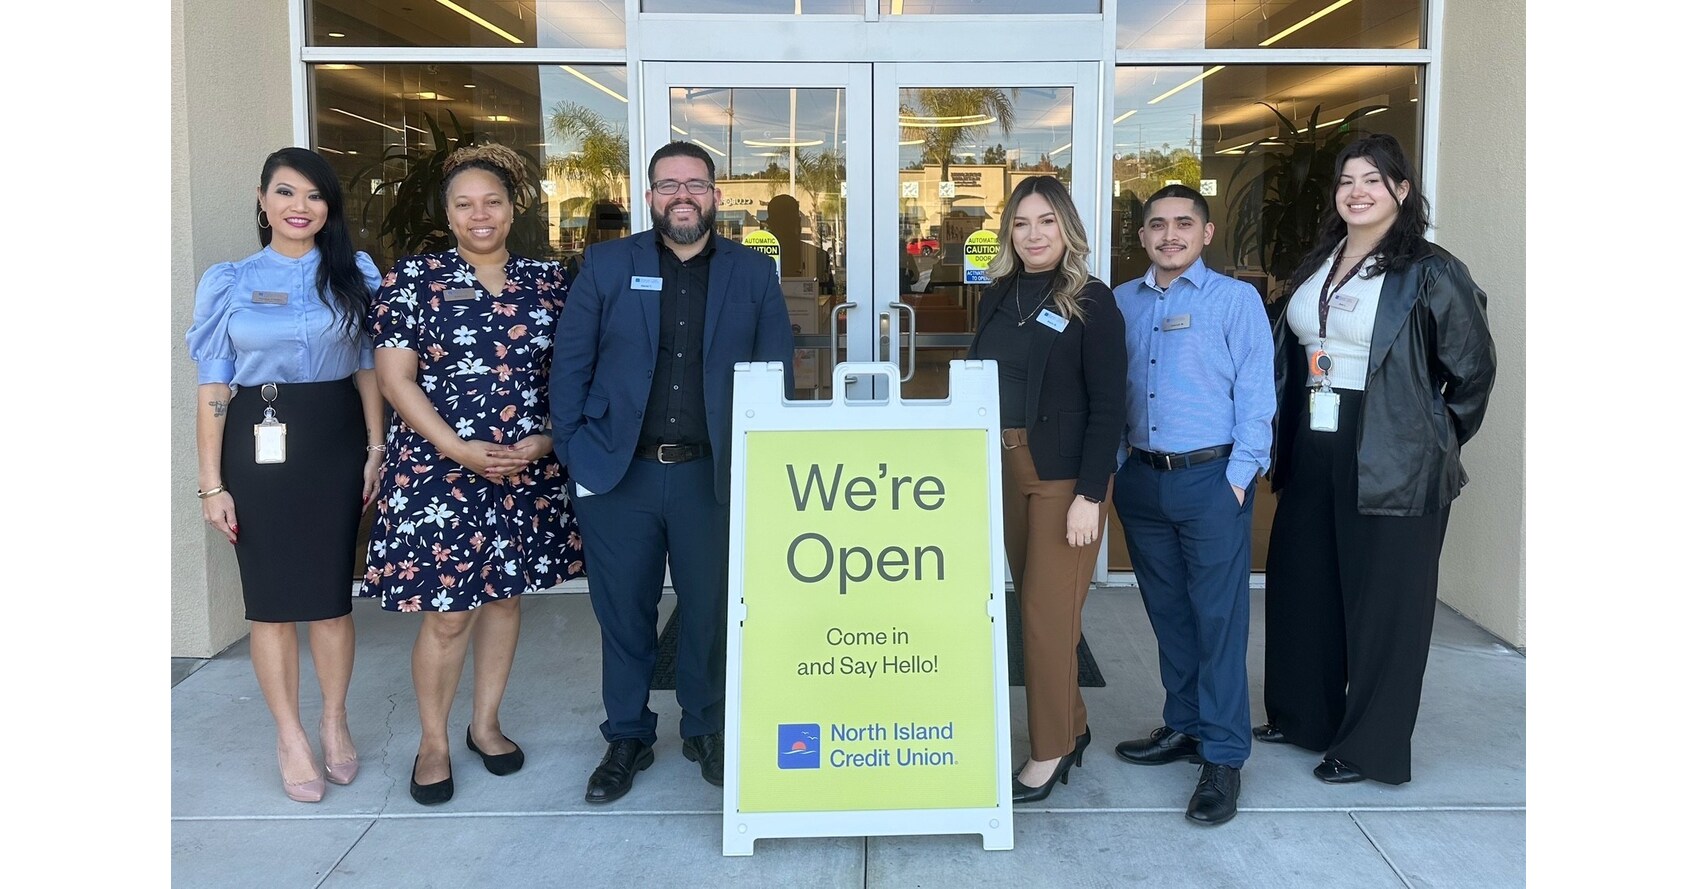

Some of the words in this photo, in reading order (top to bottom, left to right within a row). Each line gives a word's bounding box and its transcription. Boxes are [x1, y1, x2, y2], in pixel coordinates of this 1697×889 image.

[786, 463, 945, 511] We’re
[787, 533, 944, 594] Open
[827, 628, 887, 645] Come
[893, 627, 908, 644] in
[798, 657, 834, 675] and
[840, 657, 877, 678] Say
[883, 655, 937, 673] Hello!
[832, 723, 886, 741] North
[895, 722, 952, 740] Island
[830, 749, 890, 767] Credit
